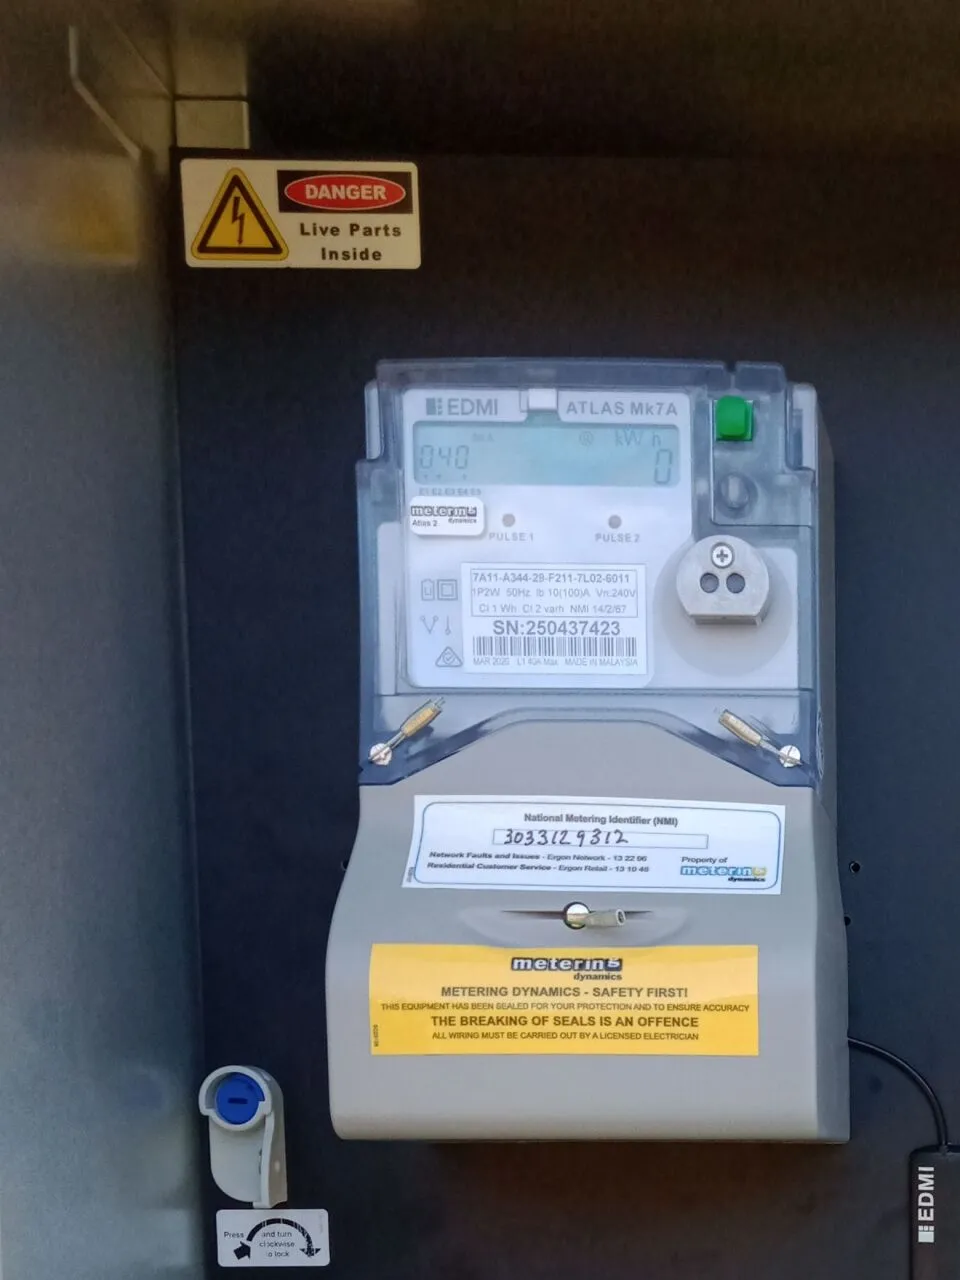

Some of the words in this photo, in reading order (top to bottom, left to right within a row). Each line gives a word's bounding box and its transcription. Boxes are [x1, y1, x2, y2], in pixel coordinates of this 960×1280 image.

[305, 184, 387, 200] DANGER
[300, 223, 339, 236] Live
[350, 223, 401, 236] Parts
[321, 247, 382, 261] Inside
[448, 399, 498, 415] EDMI
[567, 402, 624, 415] ATLAS
[631, 402, 678, 416] Mk7A
[419, 445, 468, 469] 040
[489, 532, 526, 541] PULSE
[595, 533, 632, 542] PULSE
[493, 621, 620, 635] SN:250437423
[524, 813, 563, 822] National
[566, 814, 606, 825] Metering
[609, 816, 651, 824] Identifier
[653, 817, 678, 827] (NMI)
[427, 862, 474, 870] Residential
[681, 856, 716, 864] Property
[574, 973, 622, 981] dynamics
[442, 987, 508, 997] METERING
[512, 987, 580, 997] DYNAMICS
[593, 988, 643, 997] SAFETY
[647, 988, 688, 998] FIRST!
[402, 1003, 449, 1011] EQUIPMENT
[551, 1002, 575, 1010] YOUR
[577, 1003, 632, 1011] PROTECTION
[634, 1003, 651, 1011] AND
[703, 1004, 749, 1012] ACCURACY
[431, 1016, 456, 1026] THE
[460, 1016, 527, 1026] BREAKING
[532, 1016, 548, 1026] OF
[553, 1016, 596, 1026] SEALS
[600, 1017, 612, 1026] IS
[616, 1017, 633, 1026] AN
[638, 1017, 699, 1027] OFFENCE
[560, 1032, 577, 1040] OUT
[918, 1167, 934, 1221] EDMI
